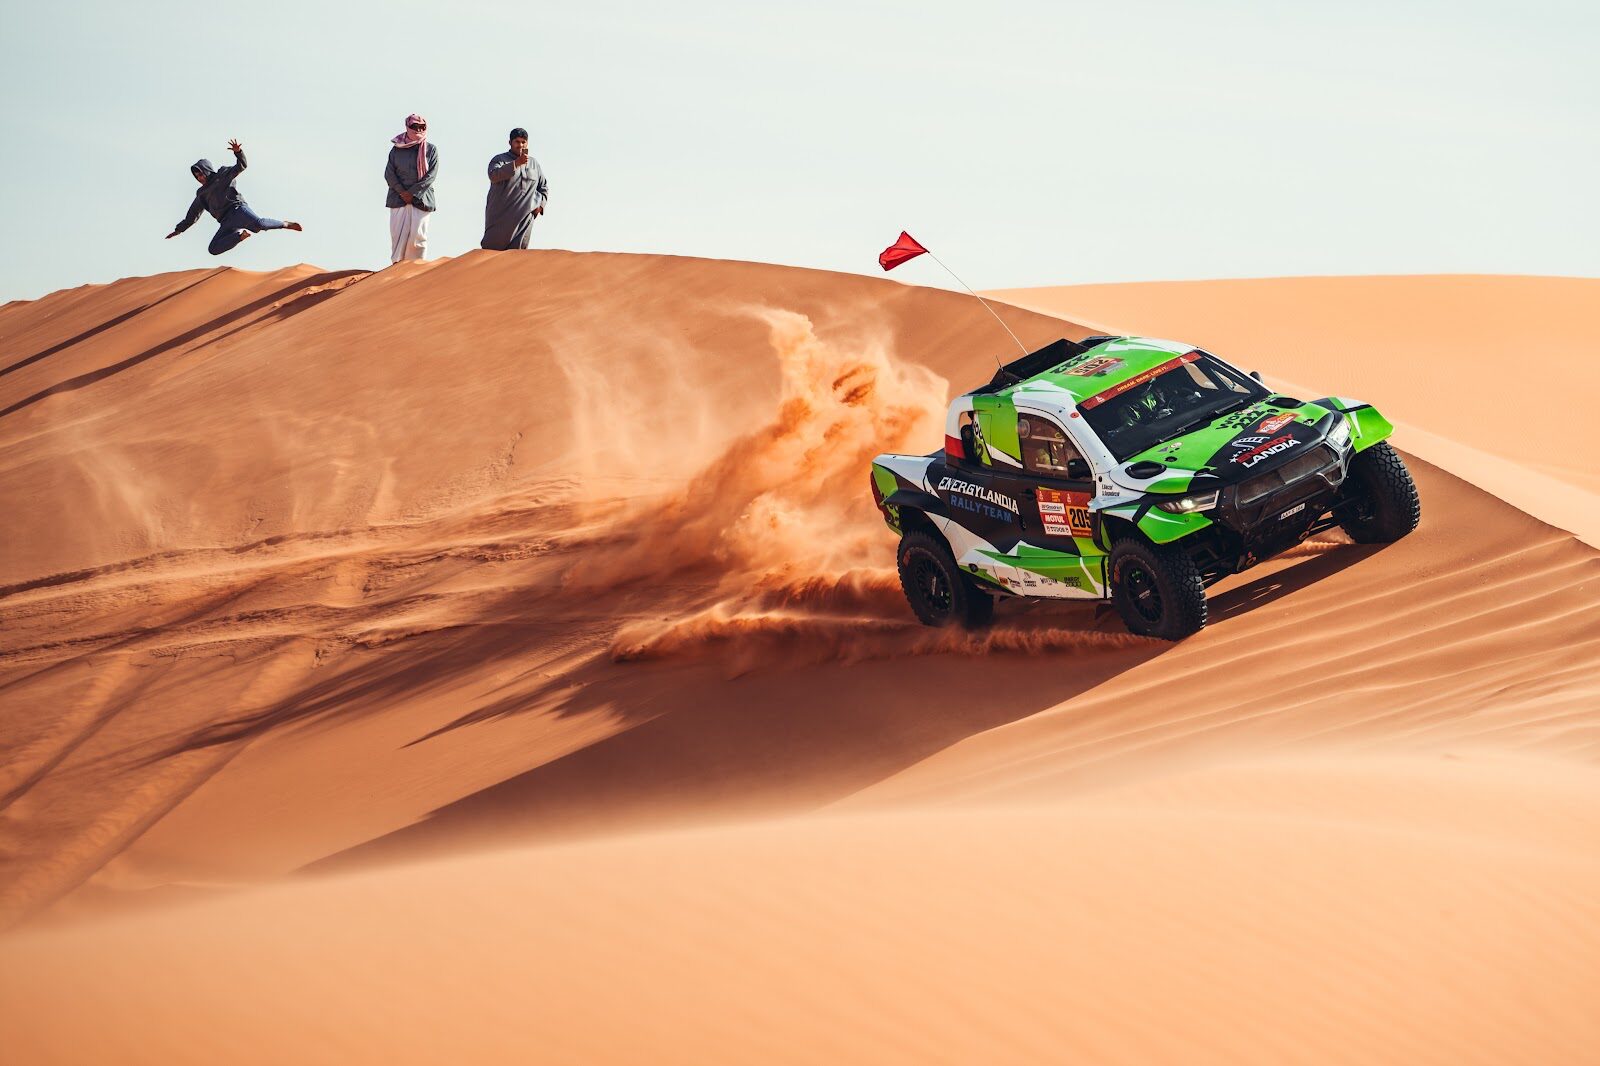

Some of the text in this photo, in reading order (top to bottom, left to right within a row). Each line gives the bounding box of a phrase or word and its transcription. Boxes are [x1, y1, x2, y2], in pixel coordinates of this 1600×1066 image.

[1237, 433, 1294, 463] ENERGY
[1242, 439, 1302, 469] LANDIA
[938, 476, 1020, 515] ENERGYLANDIA
[950, 494, 1012, 522] RALLY TEAM
[1044, 514, 1065, 523] MOTUL
